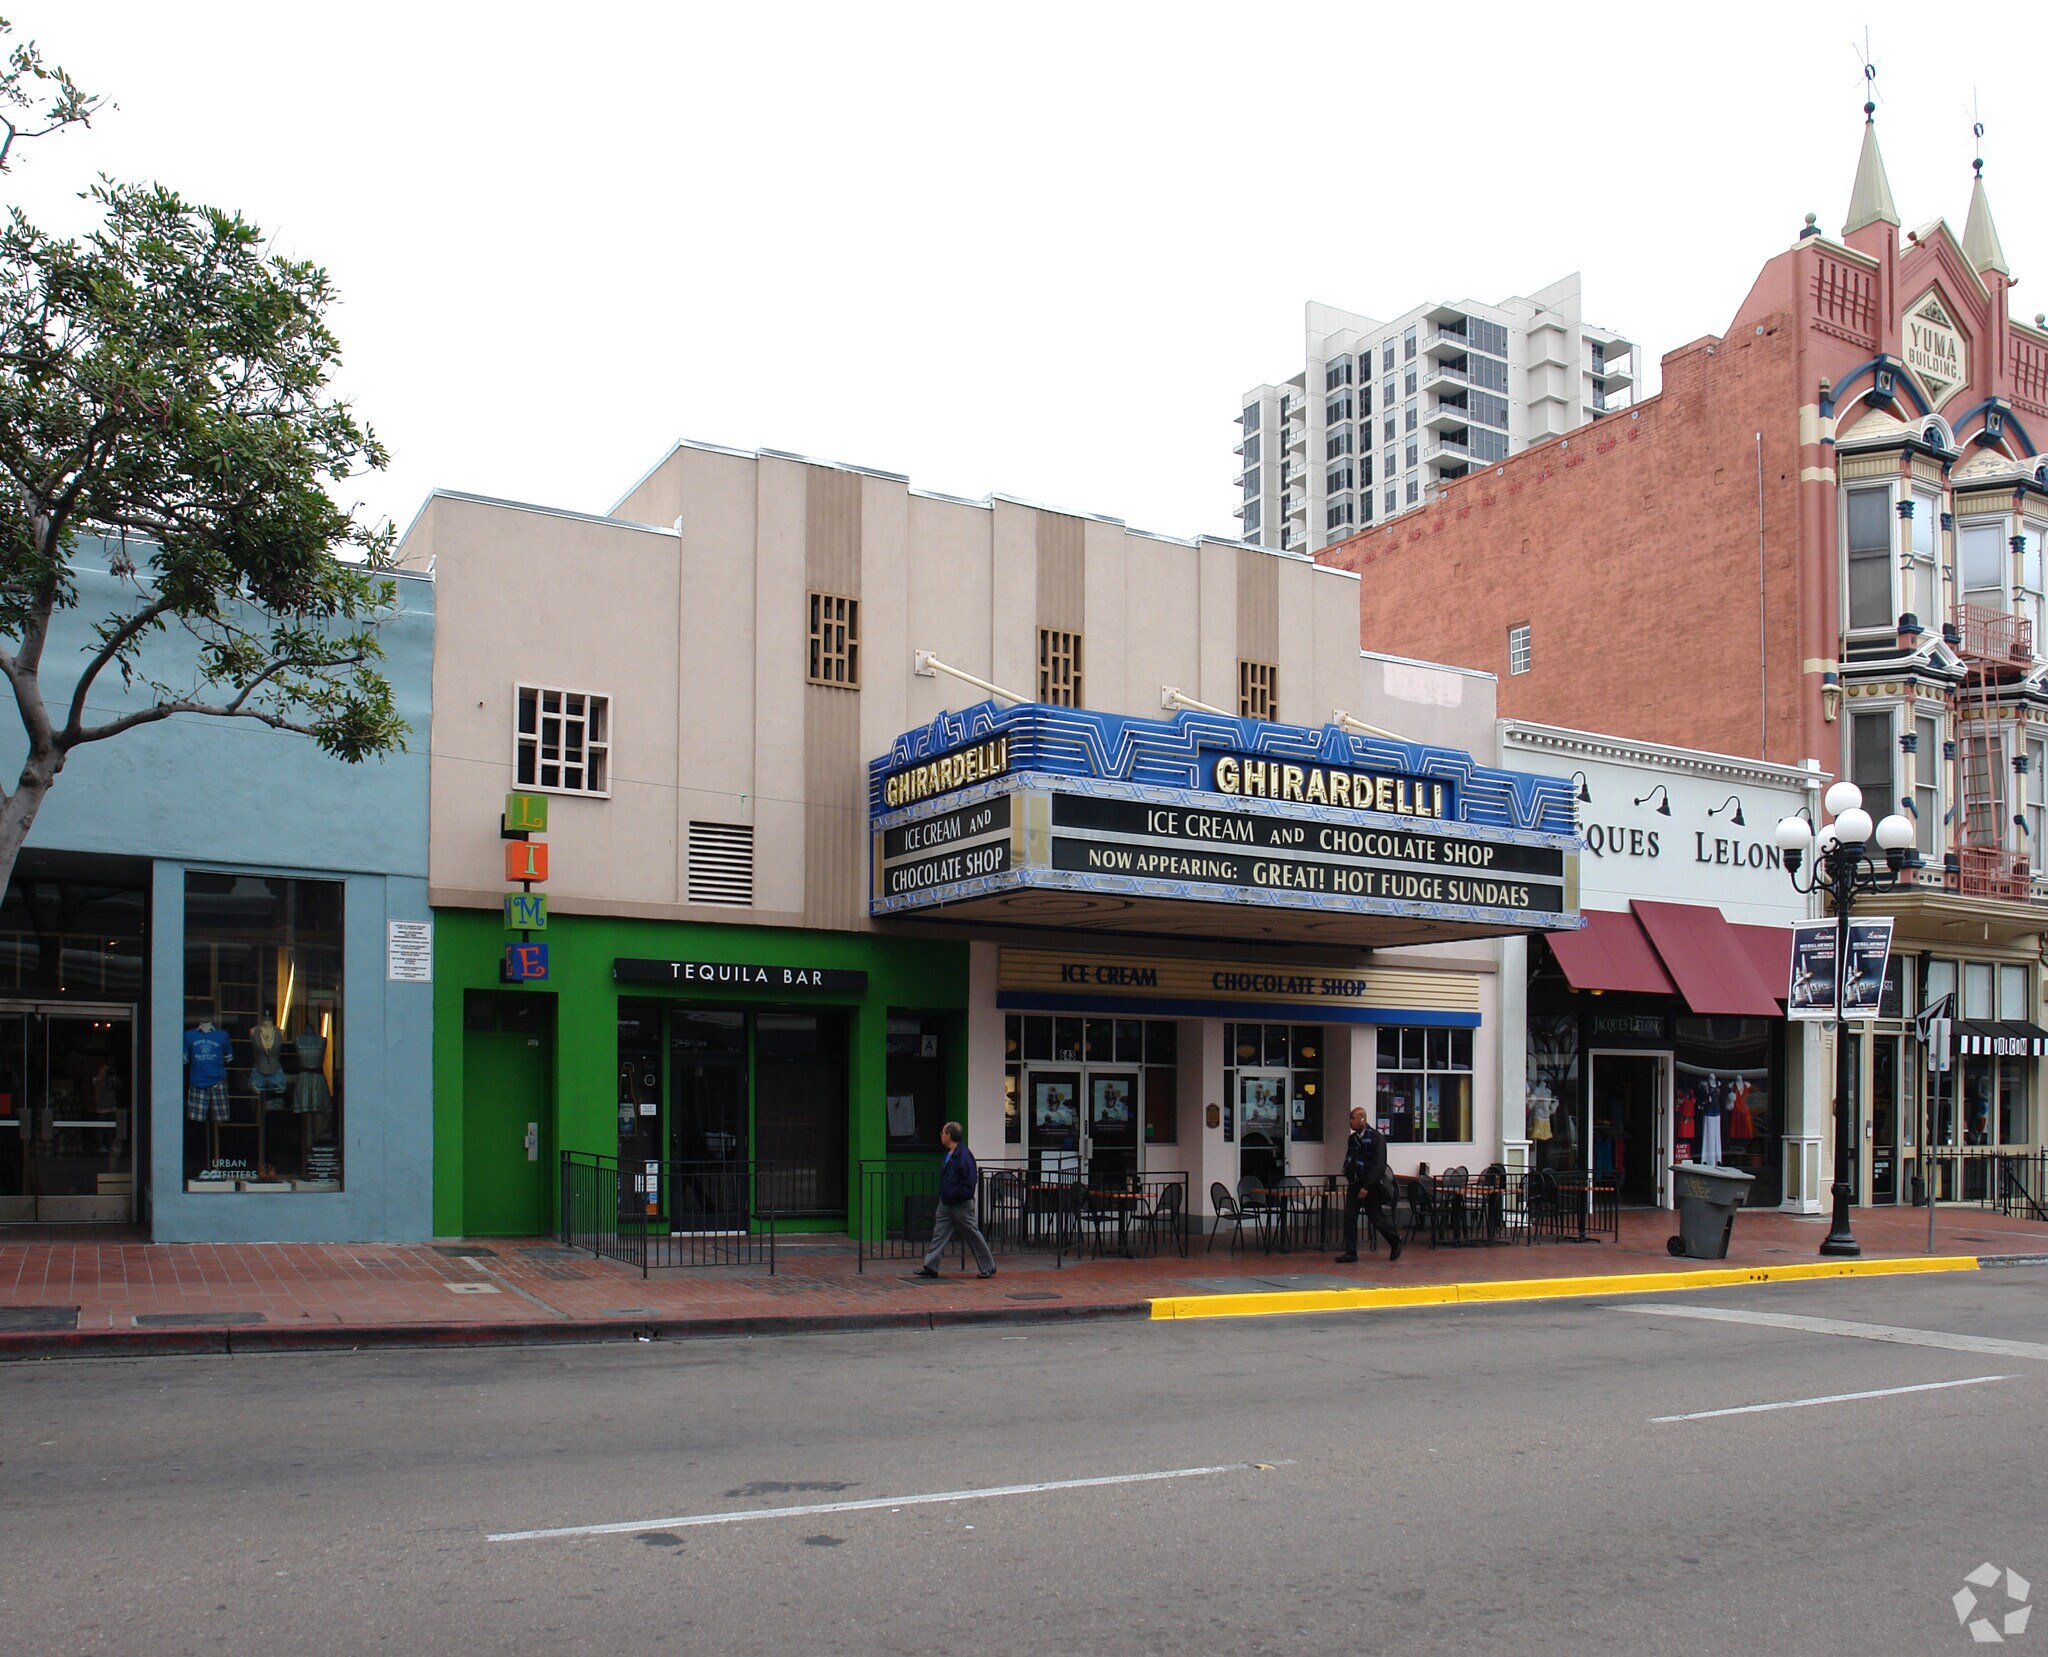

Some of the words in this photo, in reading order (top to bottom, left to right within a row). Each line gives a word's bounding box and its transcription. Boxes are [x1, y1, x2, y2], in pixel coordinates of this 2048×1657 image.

[1911, 323, 1956, 363] YUMA
[884, 737, 1006, 806] GHIRARDELLI
[1215, 756, 1441, 817] GHIRARDELLI
[905, 827, 920, 850] ICE
[923, 816, 961, 846] CREAM
[970, 809, 992, 833] AND
[1148, 810, 1178, 835] ICE
[1185, 814, 1254, 842] CREAM
[1270, 828, 1305, 845] AND
[1320, 829, 1435, 860] CHOCOLATE
[1443, 842, 1493, 866] SHOP
[892, 857, 961, 892] CHOCOLATE
[966, 847, 1003, 876] SHOP
[1090, 849, 1132, 869] NOW
[1137, 855, 1237, 879] APPEARING:
[1253, 863, 1325, 890] GREAT!
[1334, 869, 1374, 893] HOT
[1381, 873, 1442, 899] FUDGE
[1448, 880, 1529, 907] SUNDAES
[671, 963, 768, 983] TEQUILA
[784, 969, 822, 986] BAR
[1061, 963, 1089, 984] ICE
[1096, 965, 1158, 987] CREAM
[1211, 971, 1316, 994] CHOCOLATE
[1321, 977, 1367, 997] SHOP
[1593, 1016, 1628, 1034] JACQUES
[925, 1040, 933, 1050] A
[1060, 1050, 1075, 1060] 643
[1994, 1037, 2027, 1056] VOLCOM
[1295, 1105, 1302, 1113] A
[212, 1159, 247, 1167] URBAN
